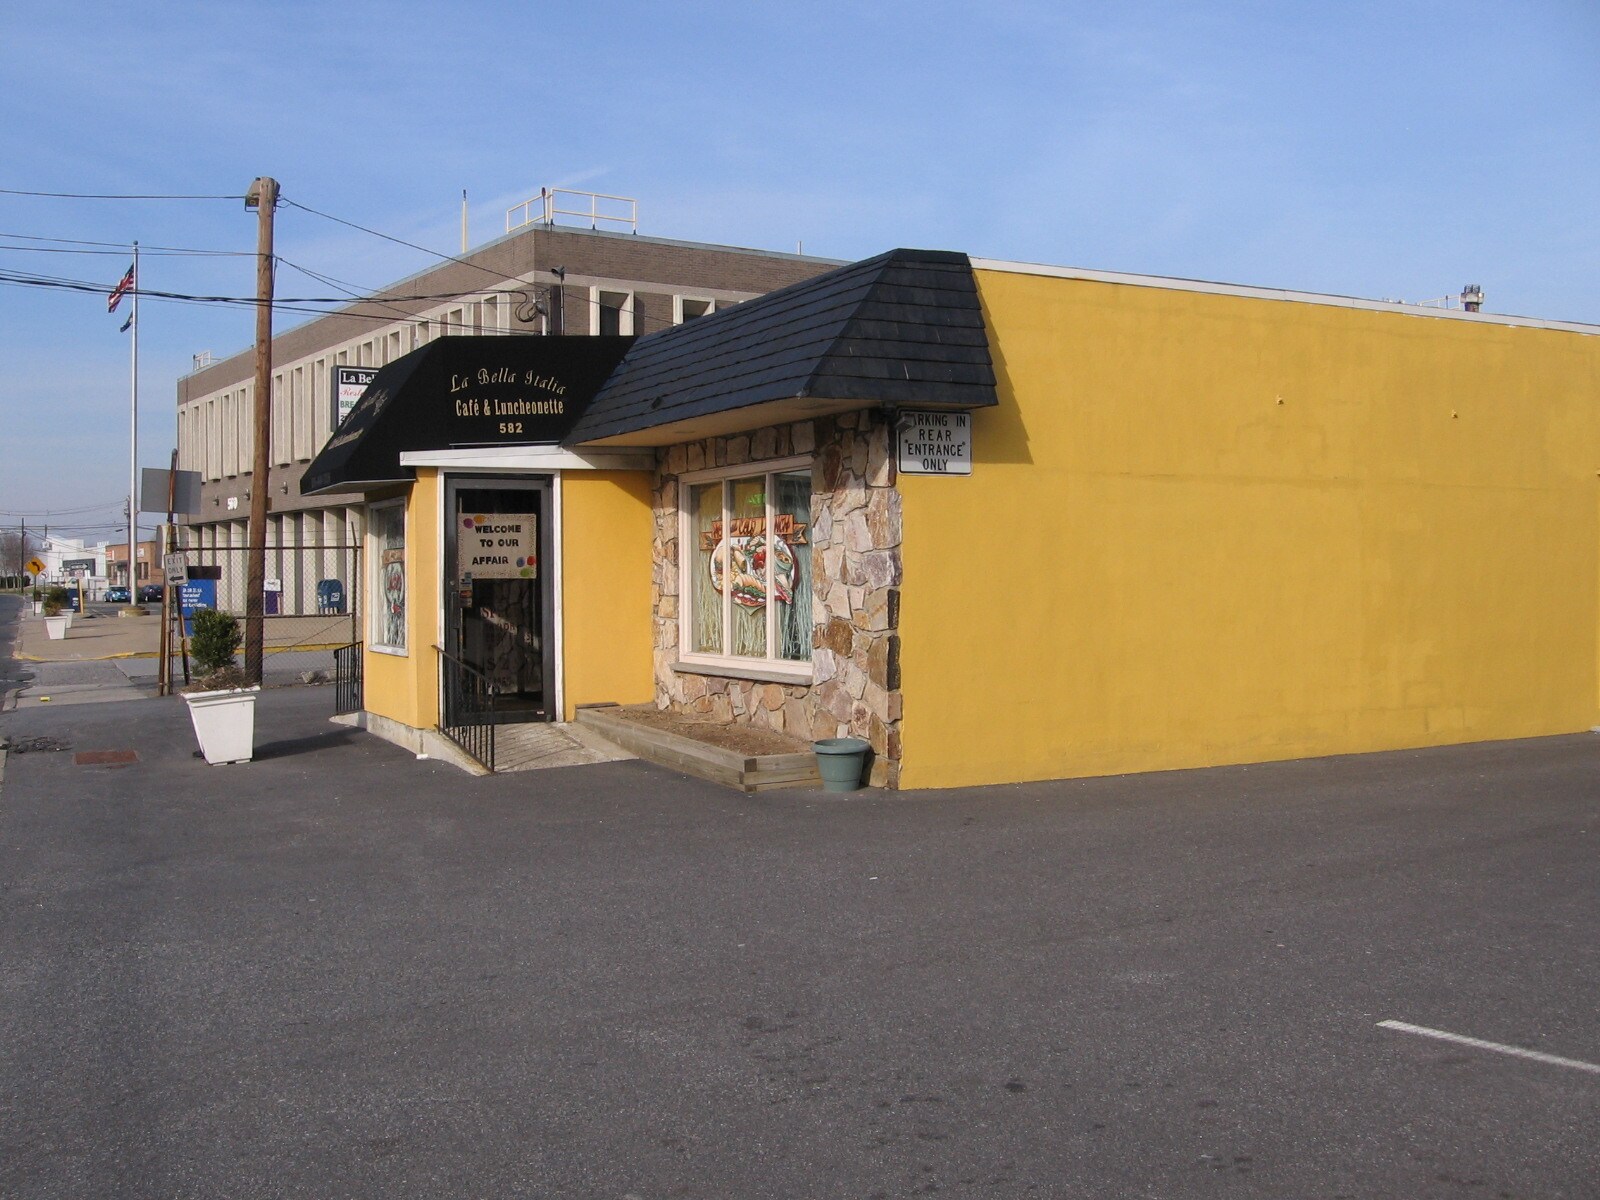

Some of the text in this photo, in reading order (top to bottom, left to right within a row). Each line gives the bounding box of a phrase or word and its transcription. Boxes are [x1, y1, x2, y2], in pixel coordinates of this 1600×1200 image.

[342, 372, 377, 384] La Bel
[450, 367, 566, 395] La Bella Italia
[340, 400, 356, 409] BRE
[455, 398, 564, 417] Café & Luncheonette
[911, 413, 966, 428] RKING IN
[499, 422, 523, 434] 582
[918, 428, 952, 442] REAR
[907, 443, 963, 457] ENTRANCE
[922, 458, 949, 471] ONLY
[474, 525, 522, 534] WELCOME
[480, 538, 519, 548] TO OUR
[167, 557, 183, 565] EXIT
[471, 556, 509, 566] AFFAIR
[168, 566, 184, 574] ONLY
